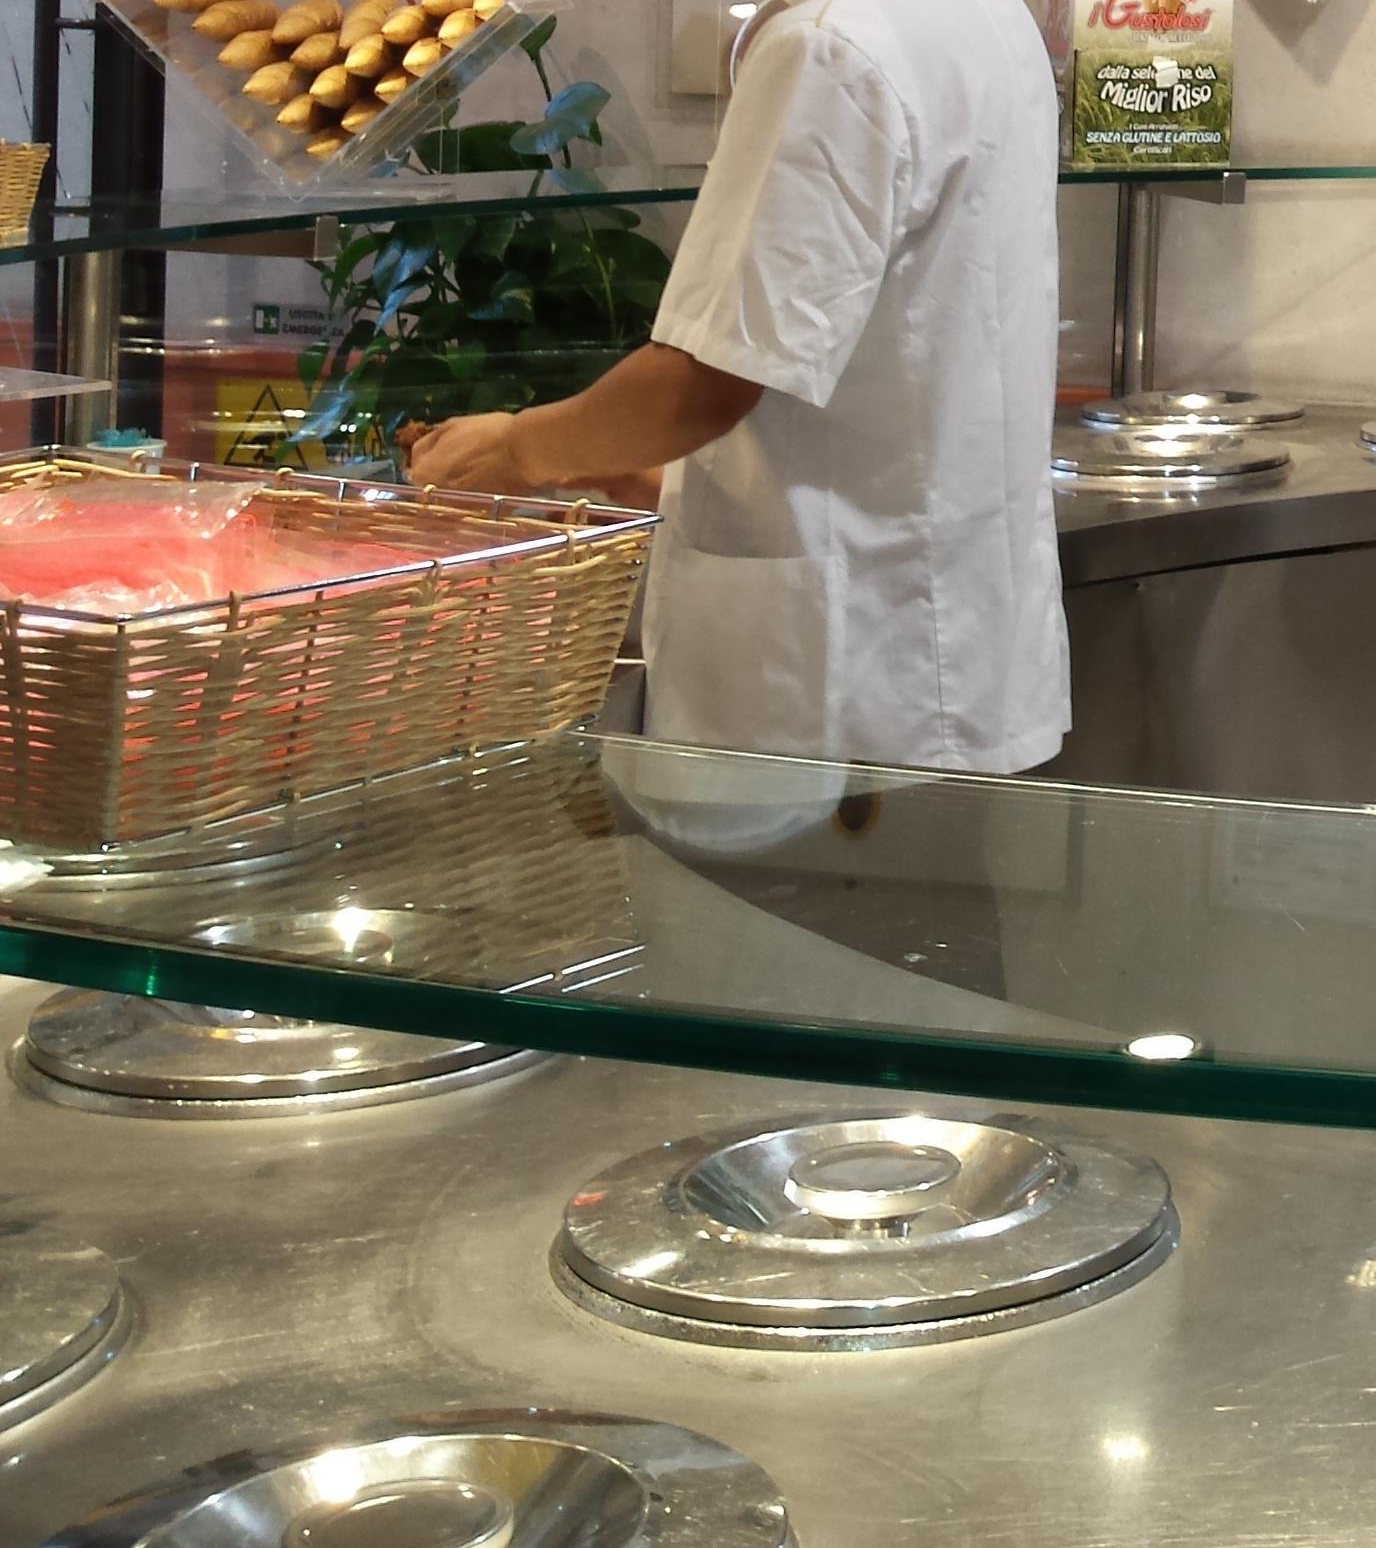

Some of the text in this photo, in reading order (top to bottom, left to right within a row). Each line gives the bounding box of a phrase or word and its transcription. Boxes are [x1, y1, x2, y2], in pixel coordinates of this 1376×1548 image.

[1097, 64, 1217, 80] dalla del
[1100, 80, 1212, 113] Miglior Riso
[1085, 132, 1121, 144] SENZA
[1122, 132, 1164, 144] GLUTINE
[1173, 132, 1221, 144] LATTOSIO
